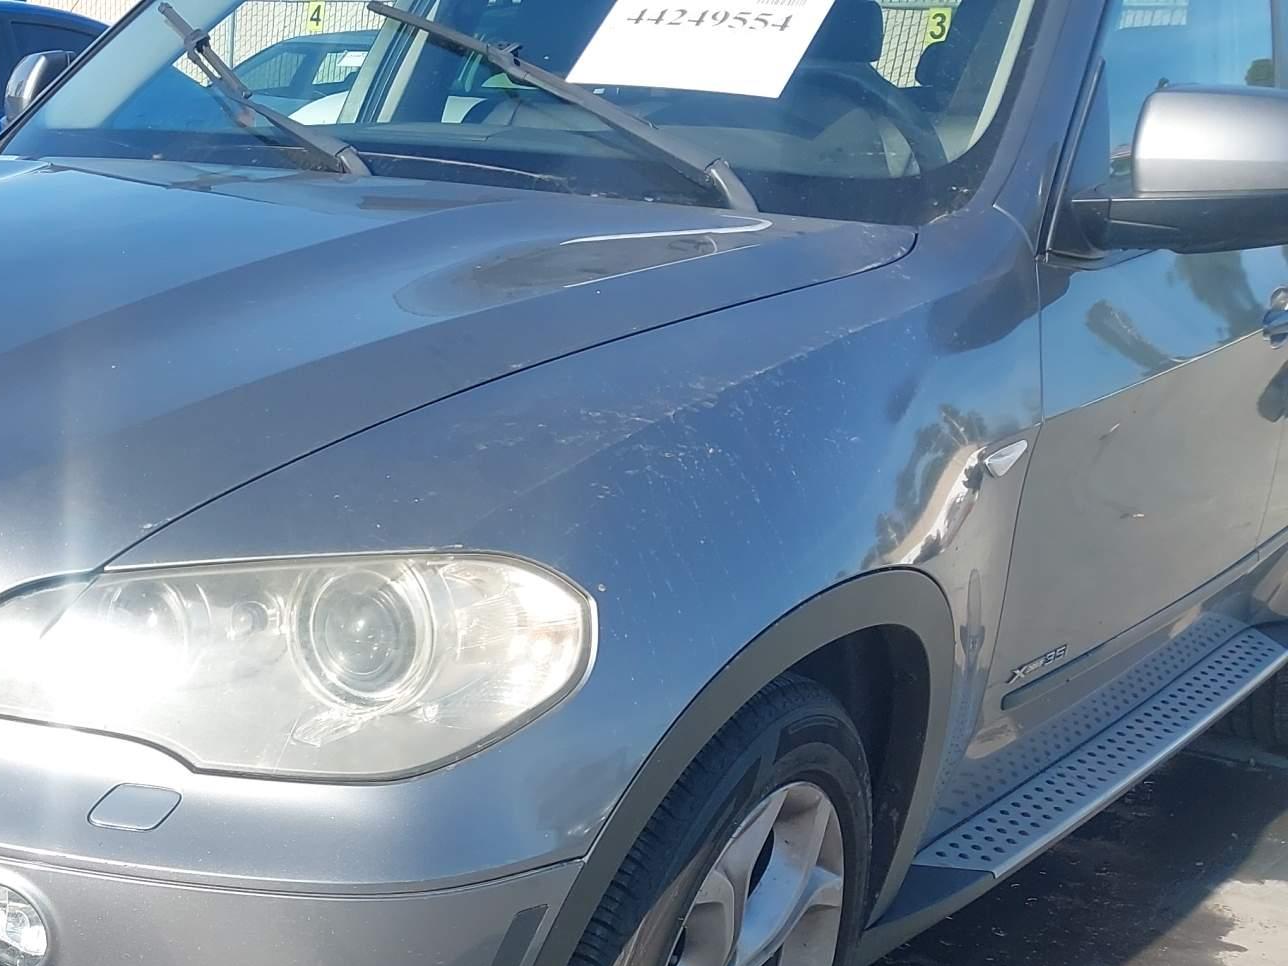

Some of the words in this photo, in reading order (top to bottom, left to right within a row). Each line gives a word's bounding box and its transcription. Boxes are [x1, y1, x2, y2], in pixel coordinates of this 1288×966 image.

[309, 4, 322, 27] 4
[626, 8, 793, 32] 44249554
[929, 12, 947, 40] 3
